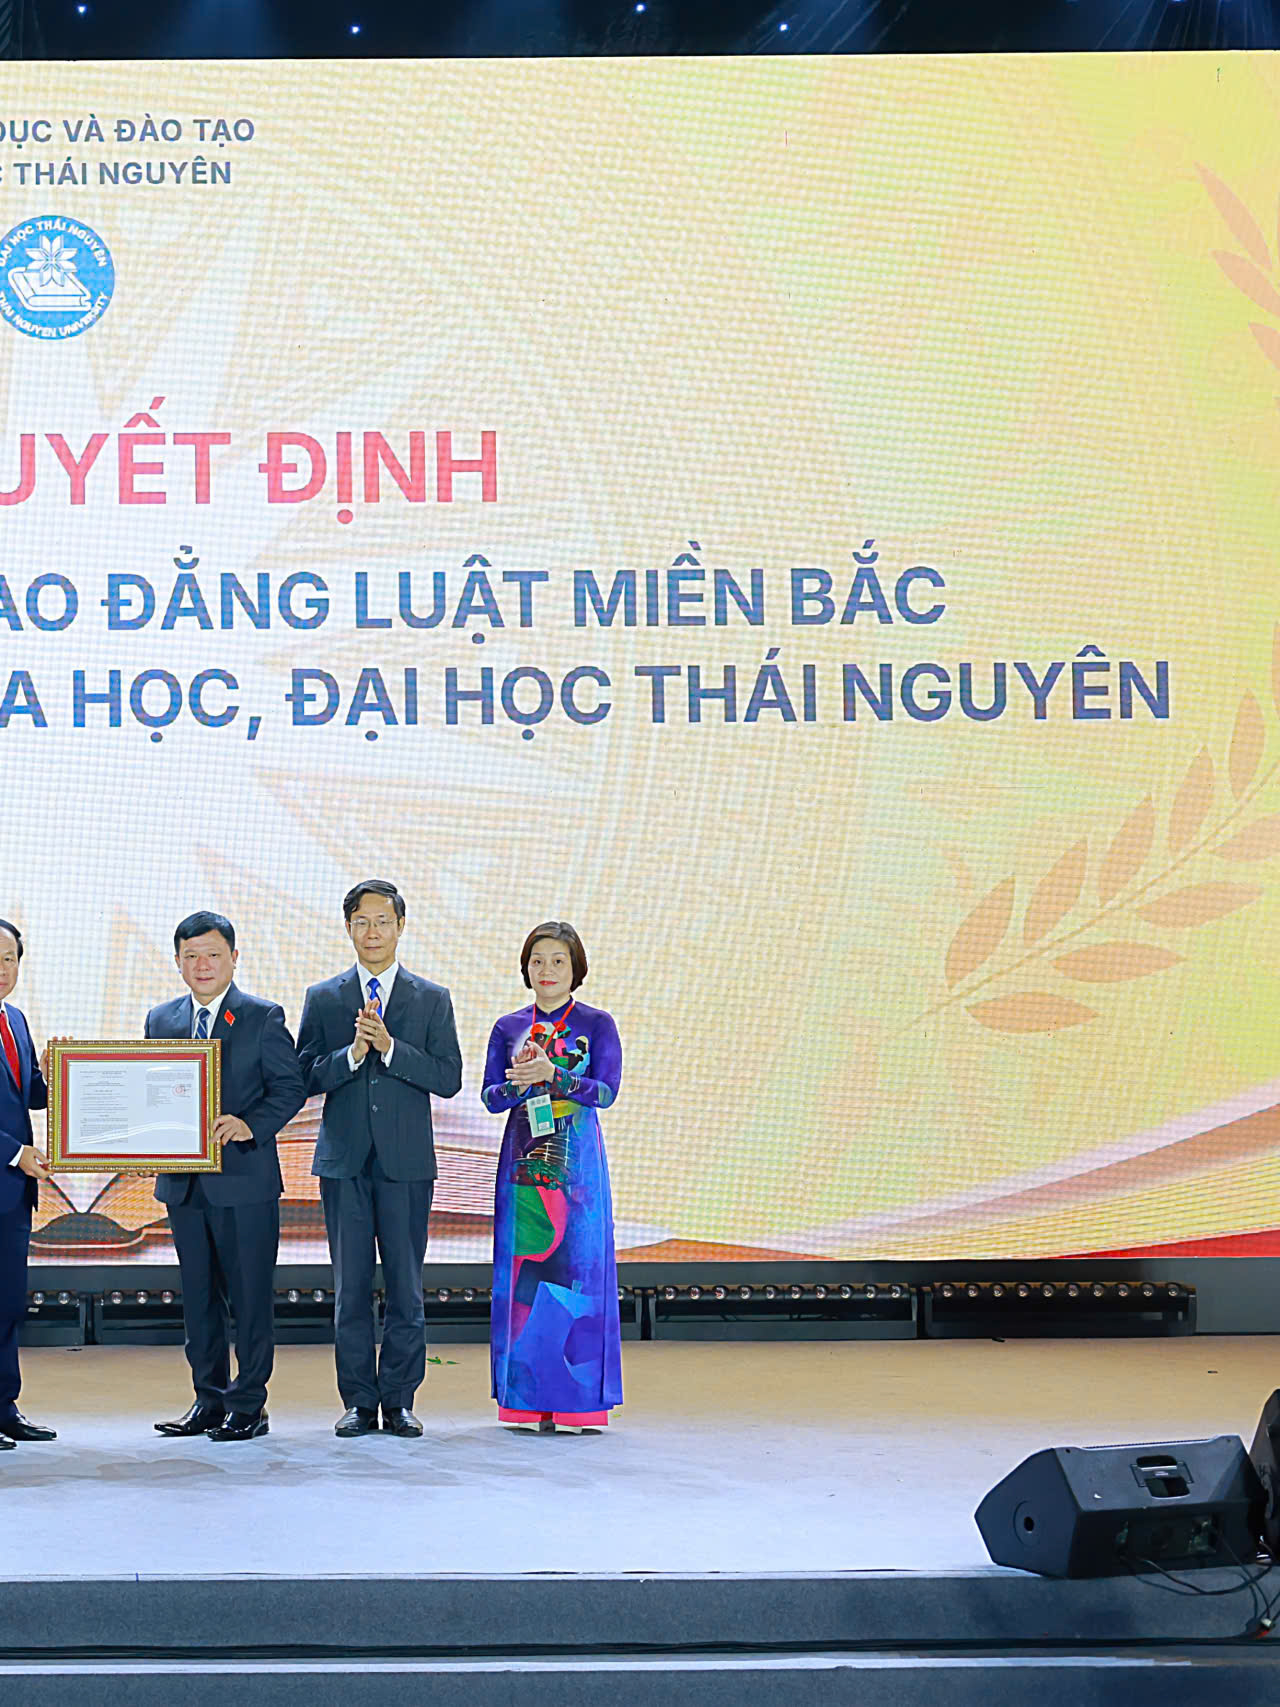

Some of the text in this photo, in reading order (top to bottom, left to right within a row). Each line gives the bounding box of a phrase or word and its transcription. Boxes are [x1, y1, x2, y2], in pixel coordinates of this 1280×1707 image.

[63, 113, 105, 142] VÀ
[114, 113, 182, 142] ĐÀO
[193, 118, 255, 148] TẠO
[13, 156, 87, 186] THÁI
[99, 155, 231, 185] NGUYÊN
[36, 218, 67, 231] THÁI
[260, 431, 497, 524] ĐỊNH
[100, 545, 330, 631] ĐẲNG
[355, 554, 549, 645] LUẬT
[573, 540, 764, 628] MIỀN
[789, 539, 946, 626] BẮC
[72, 668, 262, 743] HỌC,
[284, 667, 418, 742] ĐẠI
[445, 665, 612, 741] HỌC
[634, 647, 817, 724] THÁI
[842, 644, 1170, 722] NGUYÊN
